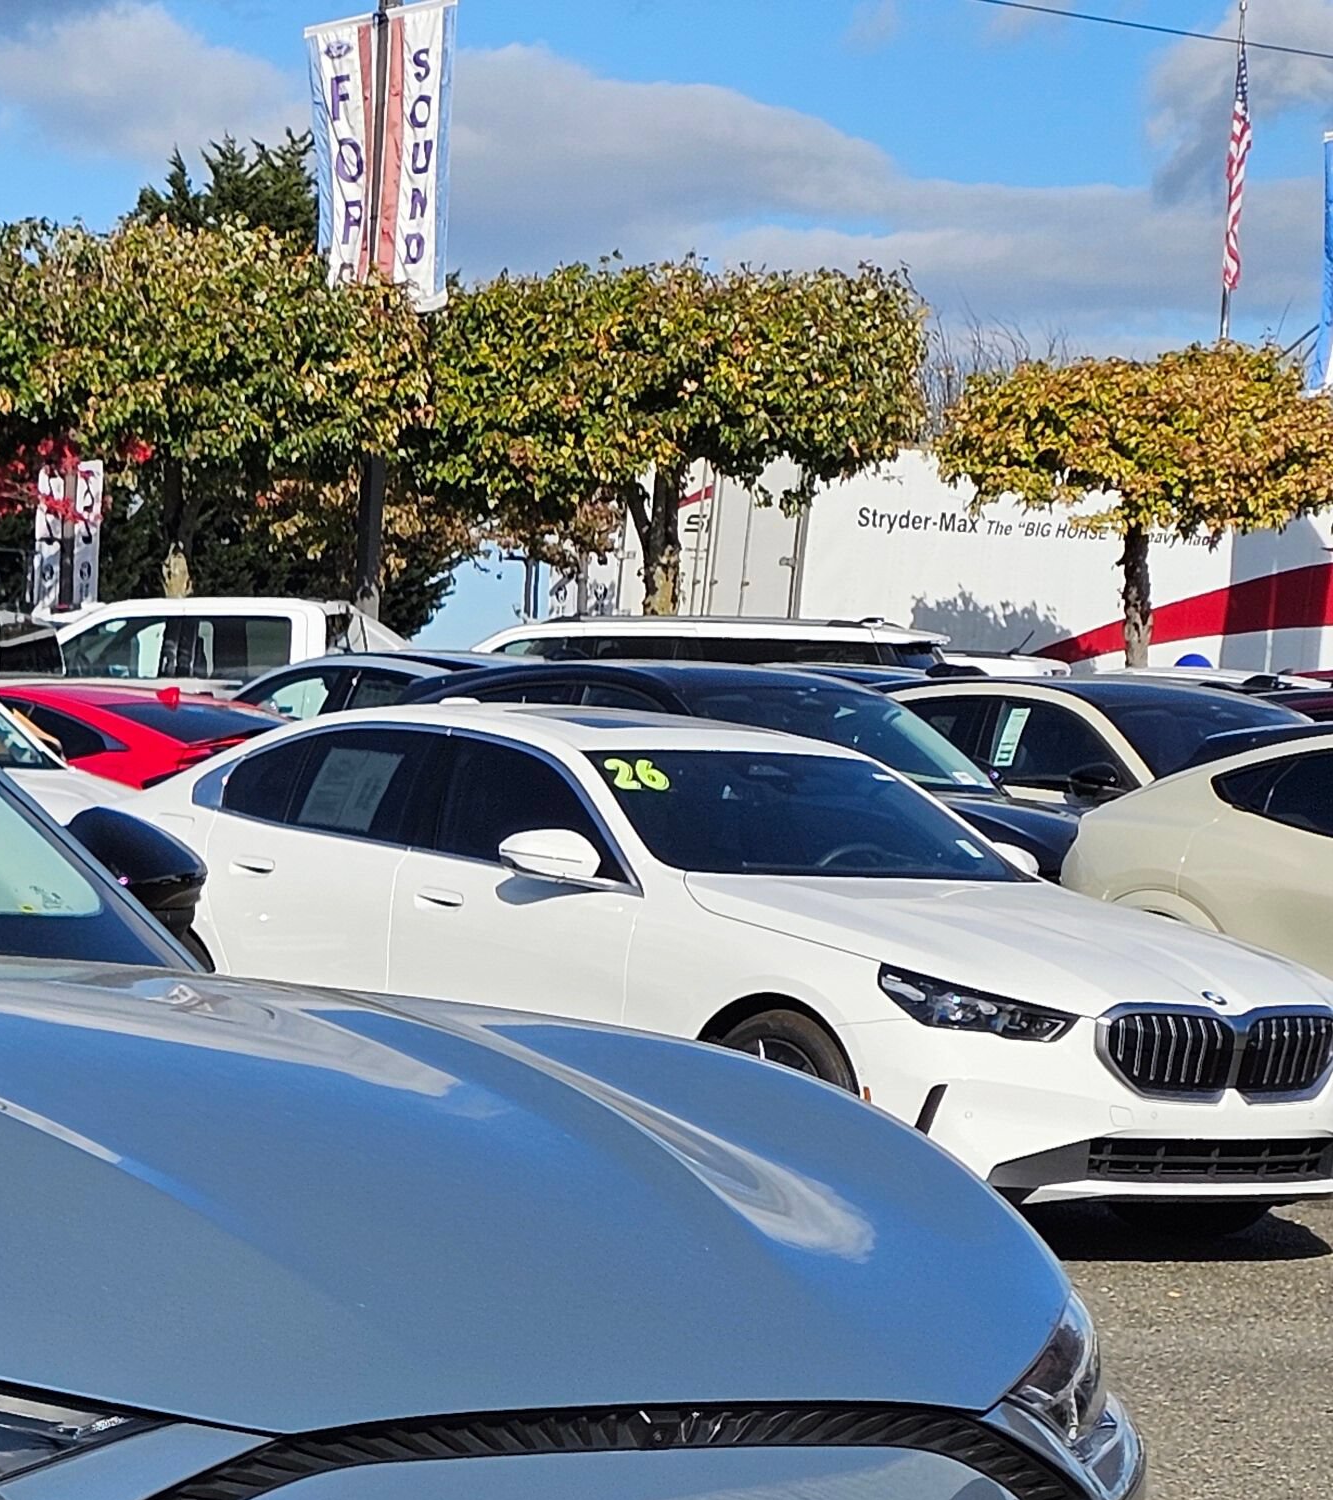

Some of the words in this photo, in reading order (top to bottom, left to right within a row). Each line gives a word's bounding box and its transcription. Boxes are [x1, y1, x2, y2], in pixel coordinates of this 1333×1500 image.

[403, 48, 433, 265] SOUND
[857, 506, 978, 534] Stryder-Max
[986, 519, 1013, 536] The
[604, 758, 670, 791] 26
